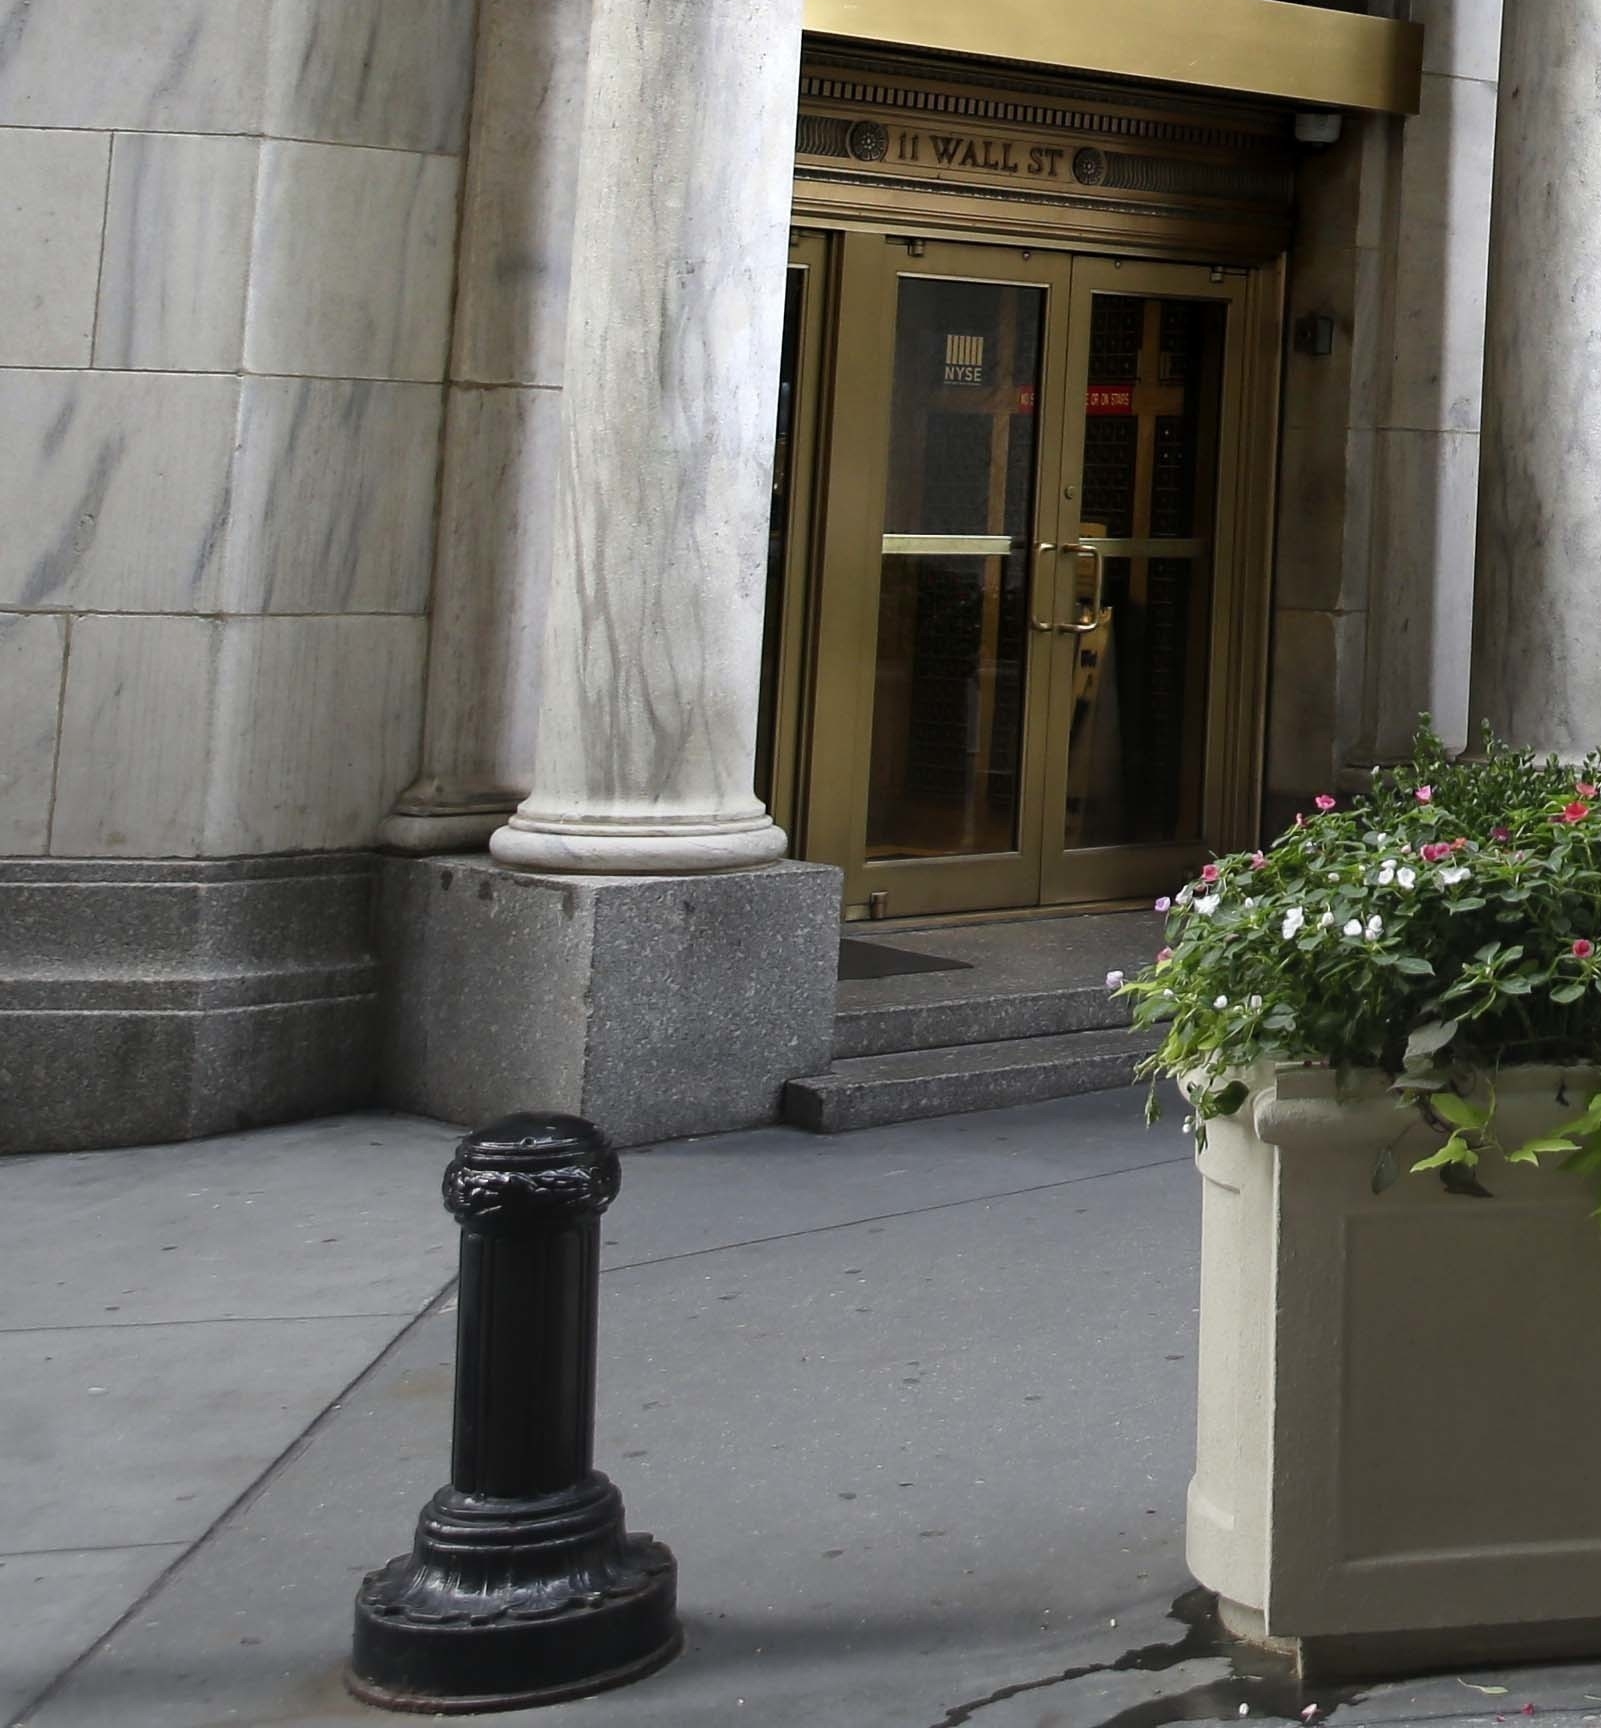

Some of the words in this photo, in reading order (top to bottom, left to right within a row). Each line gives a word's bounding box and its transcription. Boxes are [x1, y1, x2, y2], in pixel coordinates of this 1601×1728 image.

[898, 131, 919, 161] 11
[929, 135, 1018, 174] WALL
[1028, 147, 1064, 177] ST
[944, 366, 982, 382] NYSE
